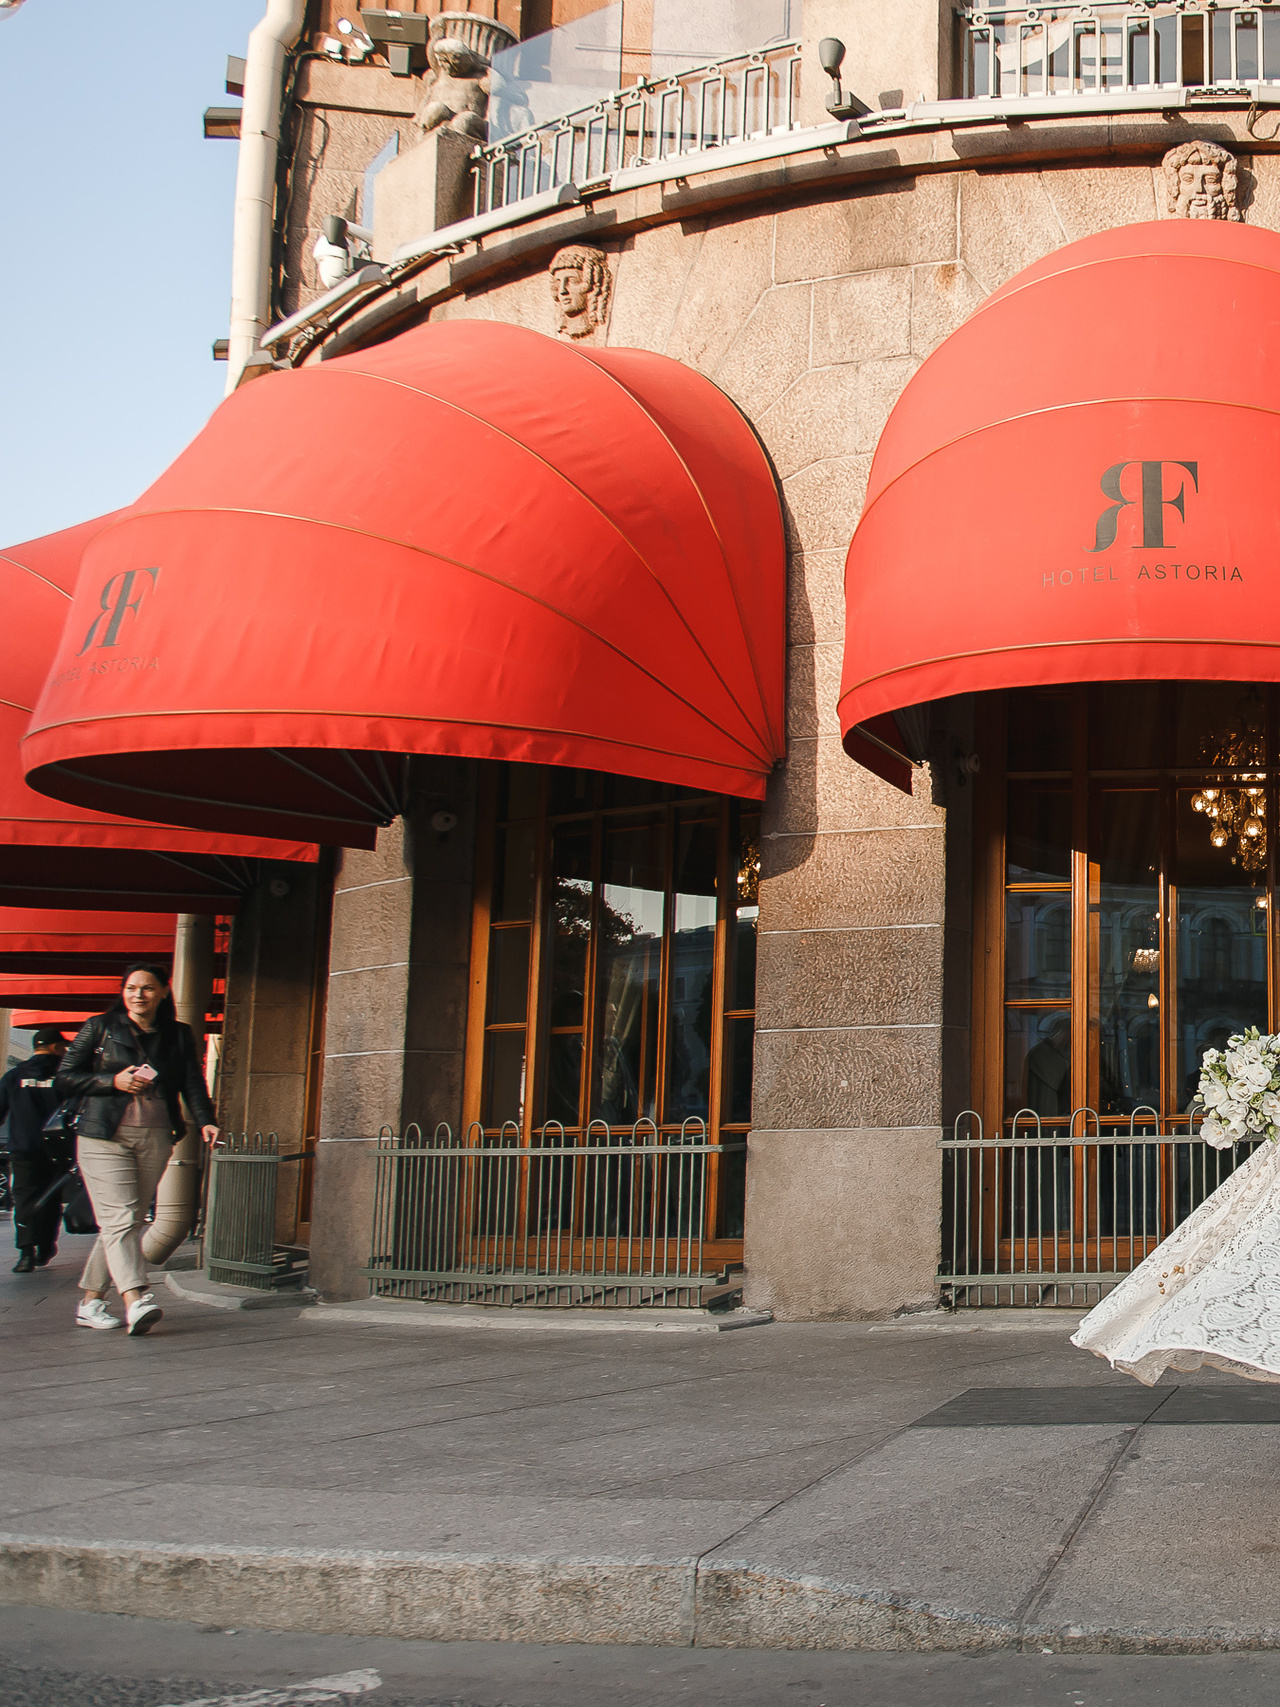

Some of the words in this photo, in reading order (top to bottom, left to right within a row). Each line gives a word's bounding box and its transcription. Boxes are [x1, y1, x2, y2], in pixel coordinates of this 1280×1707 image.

[1042, 566, 1120, 588] HOTEL
[1137, 564, 1244, 582] ASTORIA
[89, 656, 161, 675] ASTORIA
